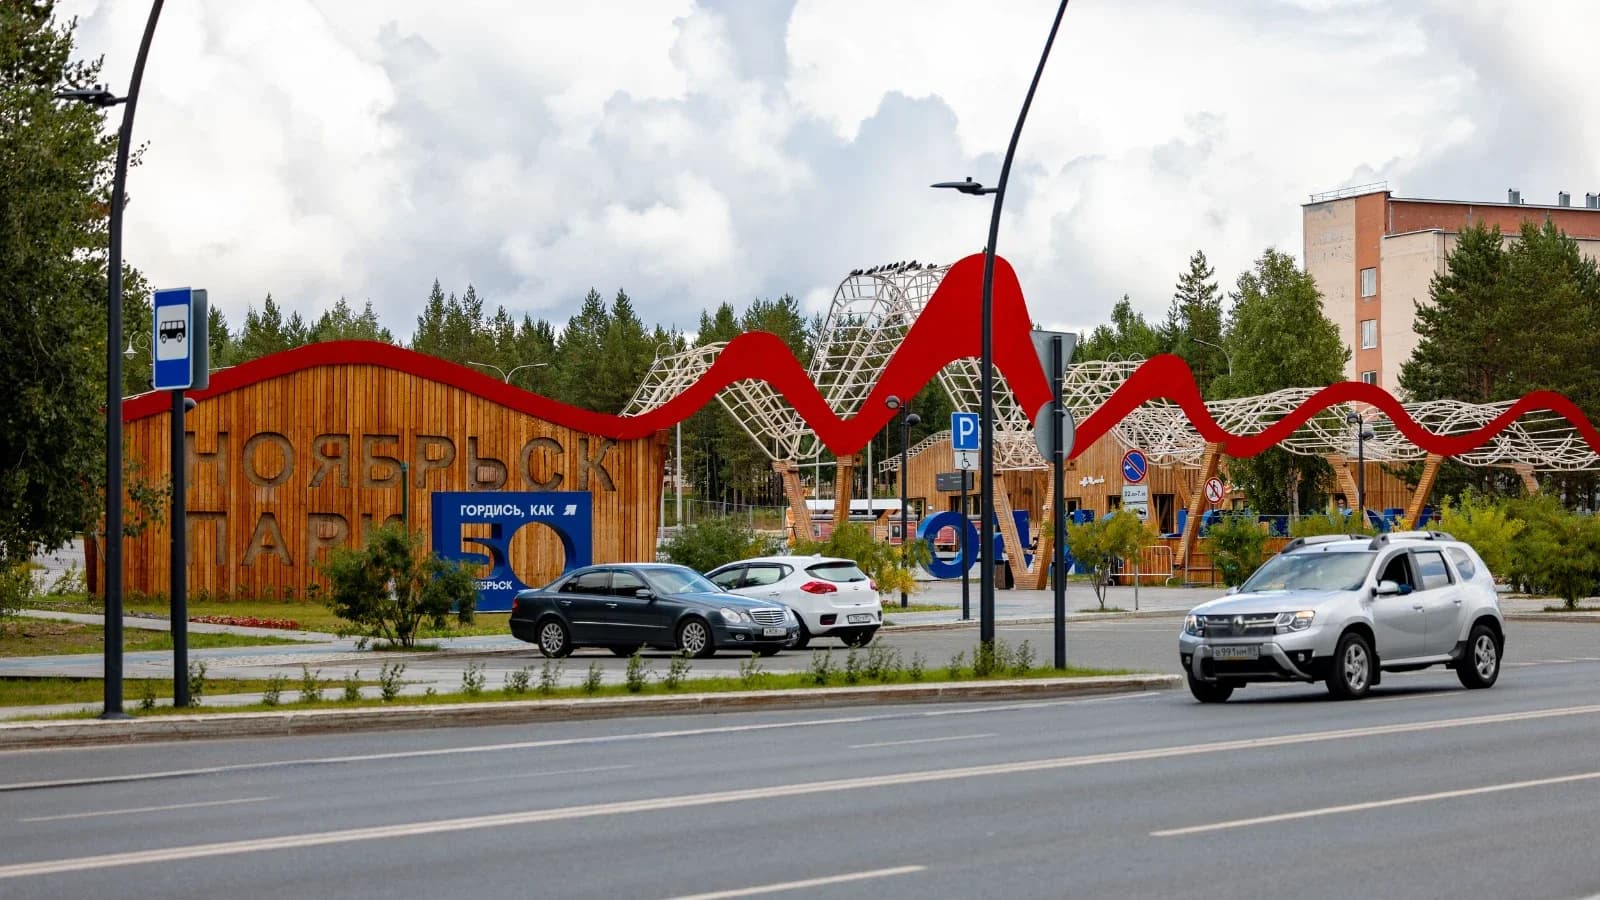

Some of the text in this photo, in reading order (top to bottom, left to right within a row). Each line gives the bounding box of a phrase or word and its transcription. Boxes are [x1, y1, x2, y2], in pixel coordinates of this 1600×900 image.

[959, 416, 974, 446] P
[185, 431, 617, 491] НОЯБРЬСК
[460, 504, 525, 517] ГОРДИСЬ,
[530, 504, 555, 516] КАК
